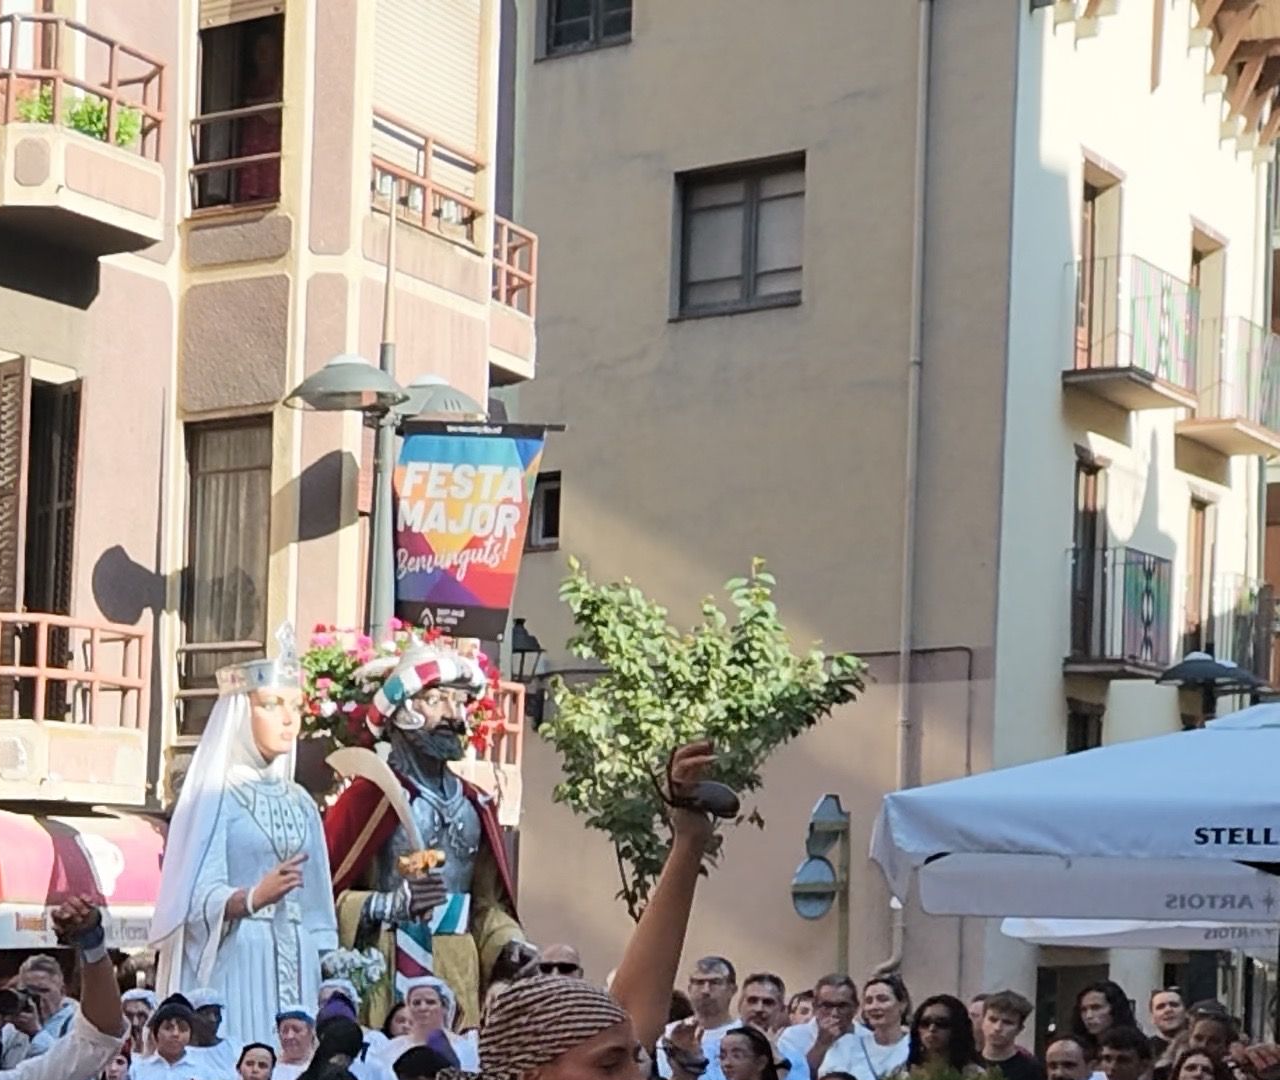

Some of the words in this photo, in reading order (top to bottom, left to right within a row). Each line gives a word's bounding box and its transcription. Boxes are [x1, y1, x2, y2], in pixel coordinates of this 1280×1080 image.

[401, 461, 524, 503] FESTA
[397, 499, 520, 538] MAJOR
[396, 536, 512, 582] Benvinguts!
